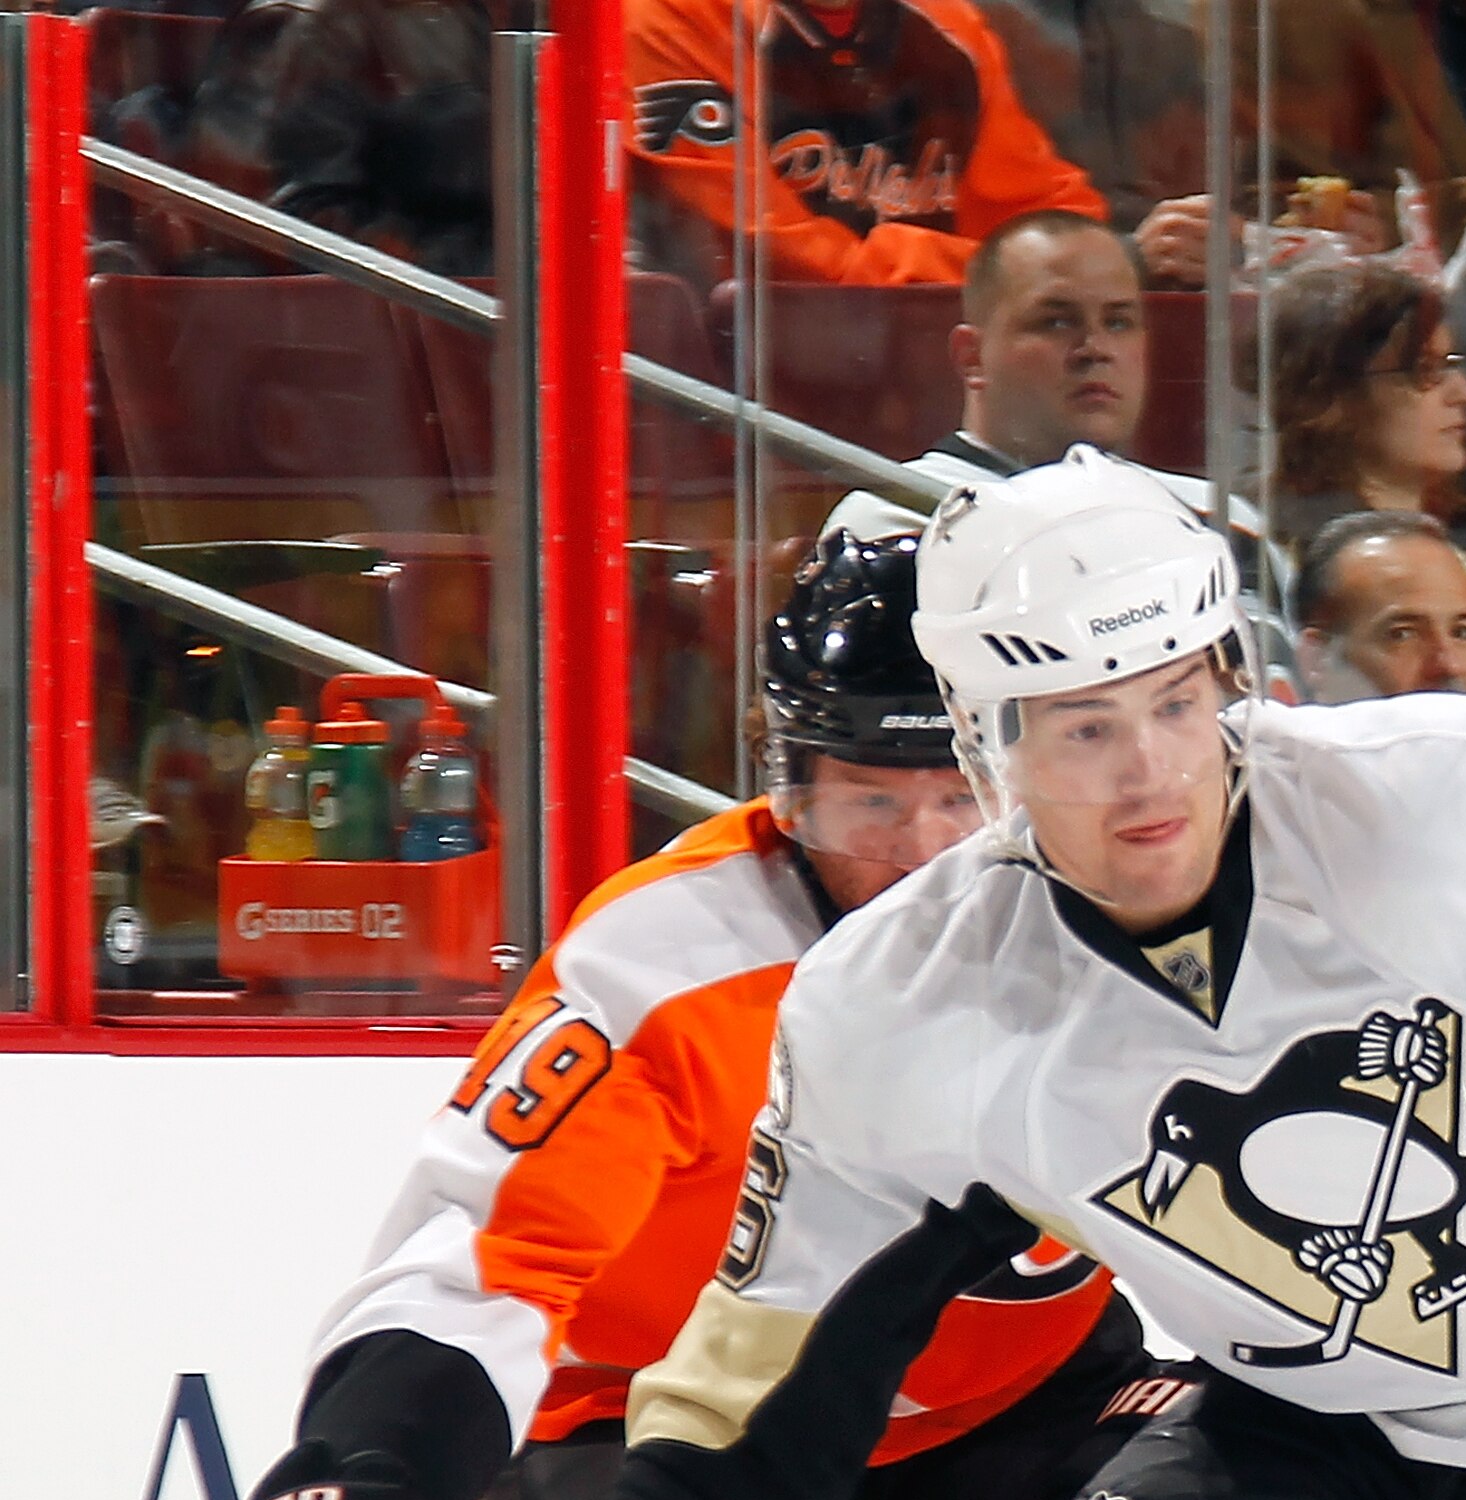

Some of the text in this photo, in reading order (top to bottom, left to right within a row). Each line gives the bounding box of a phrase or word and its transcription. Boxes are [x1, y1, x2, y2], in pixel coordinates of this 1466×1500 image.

[1088, 598, 1167, 637] Reebok
[880, 715, 951, 729] BAUE
[266, 908, 356, 934] SERIES
[361, 903, 407, 939] 02
[450, 995, 612, 1152] 19
